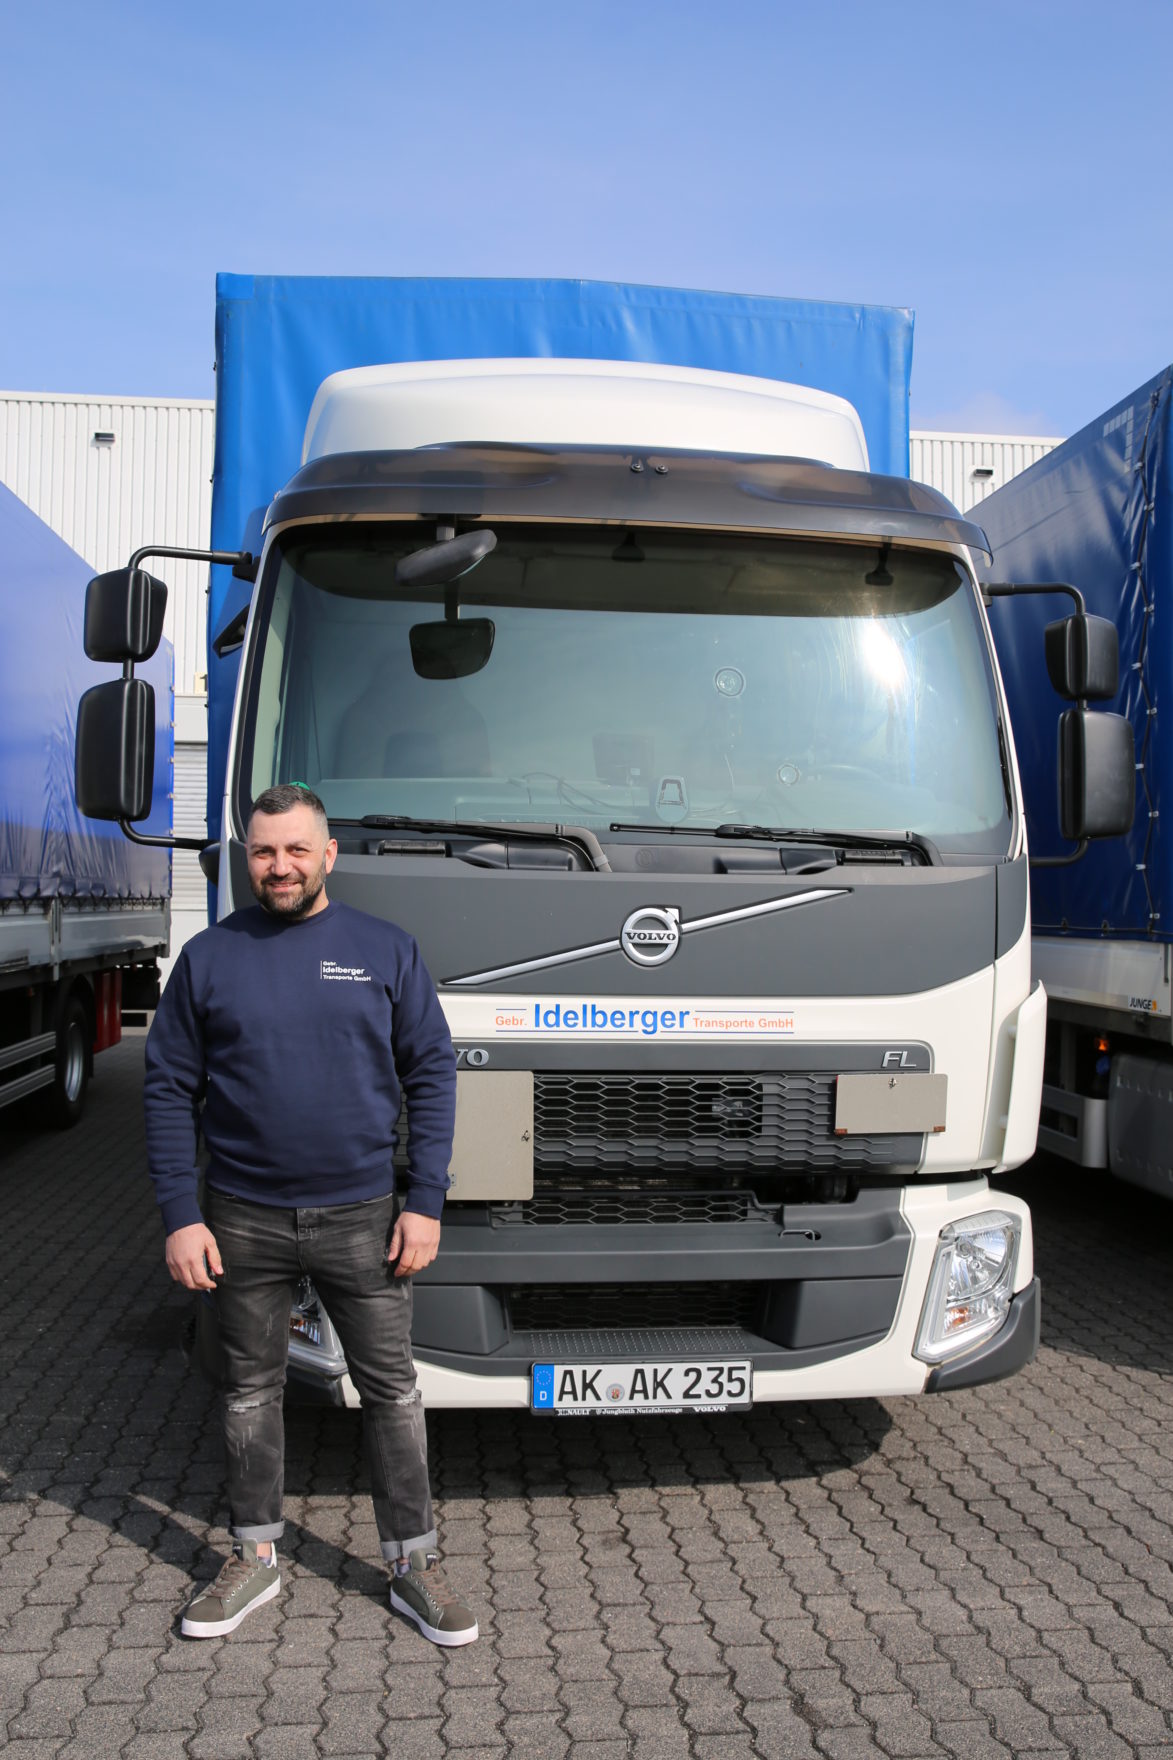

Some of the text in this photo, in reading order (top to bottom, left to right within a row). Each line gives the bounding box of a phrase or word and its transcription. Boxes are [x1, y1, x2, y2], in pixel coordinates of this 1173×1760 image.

[625, 932, 677, 941] VOLVO
[323, 966, 365, 976] Idelberger
[1130, 997, 1152, 1010] JUNGE
[495, 1003, 794, 1035] Gebr. Idelberger Transporte GmbH
[882, 1050, 917, 1067] FL
[558, 1366, 747, 1402] AK AK 235
[540, 1391, 547, 1400] D
[693, 1405, 727, 1413] VOLVO
